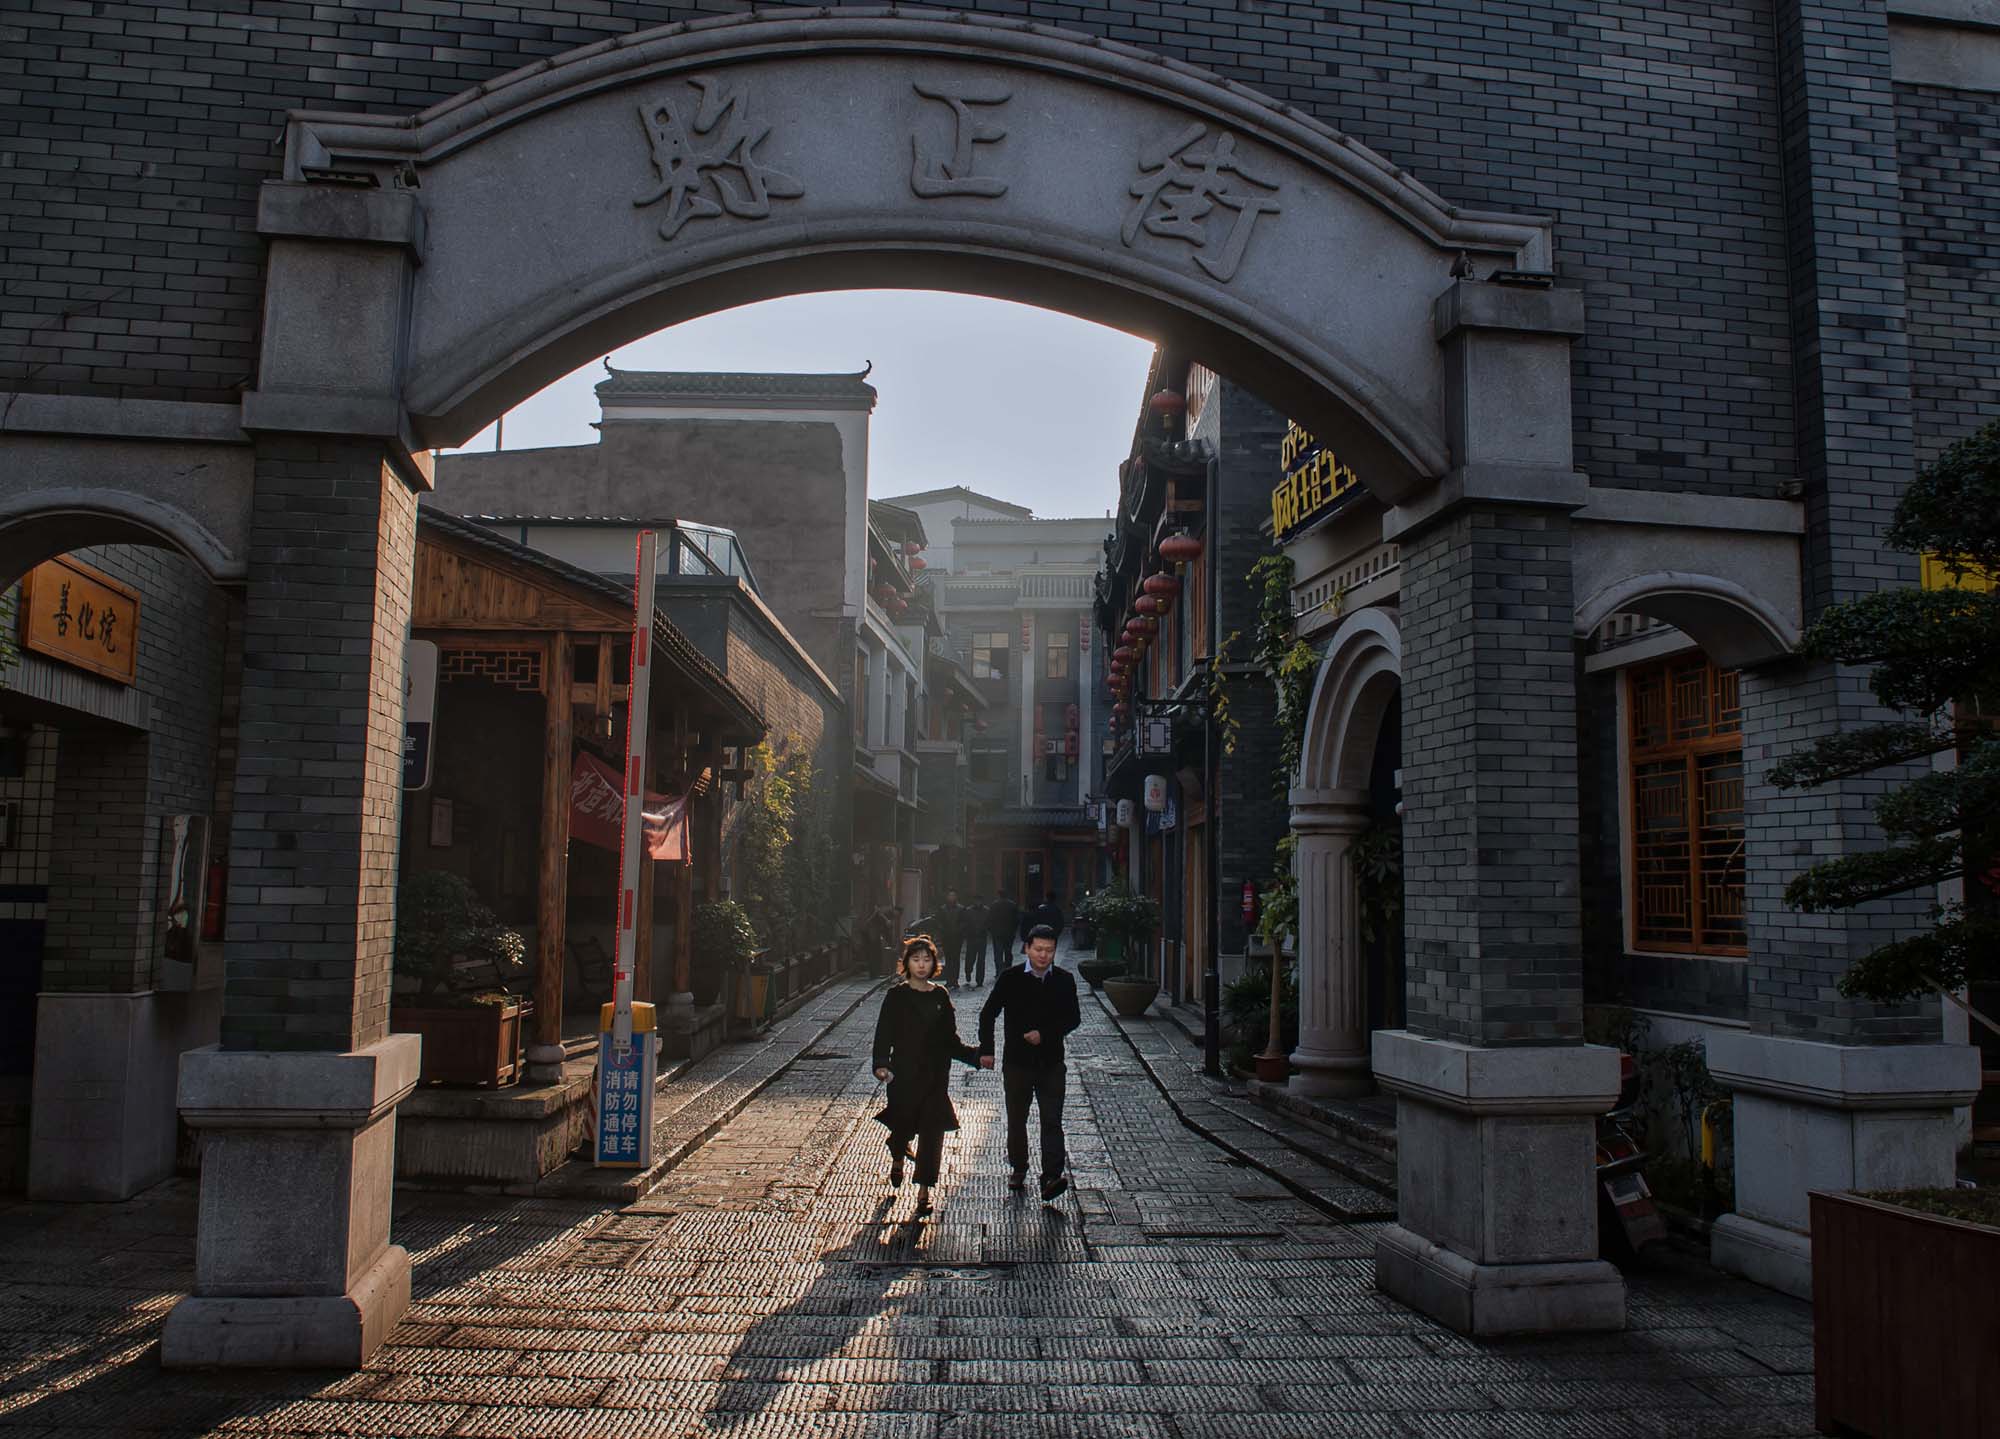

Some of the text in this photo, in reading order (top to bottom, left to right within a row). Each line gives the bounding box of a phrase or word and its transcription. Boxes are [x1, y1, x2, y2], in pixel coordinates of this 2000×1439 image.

[602, 1070, 621, 1154] 消防通道
[620, 1070, 639, 1154] 请勿停车
